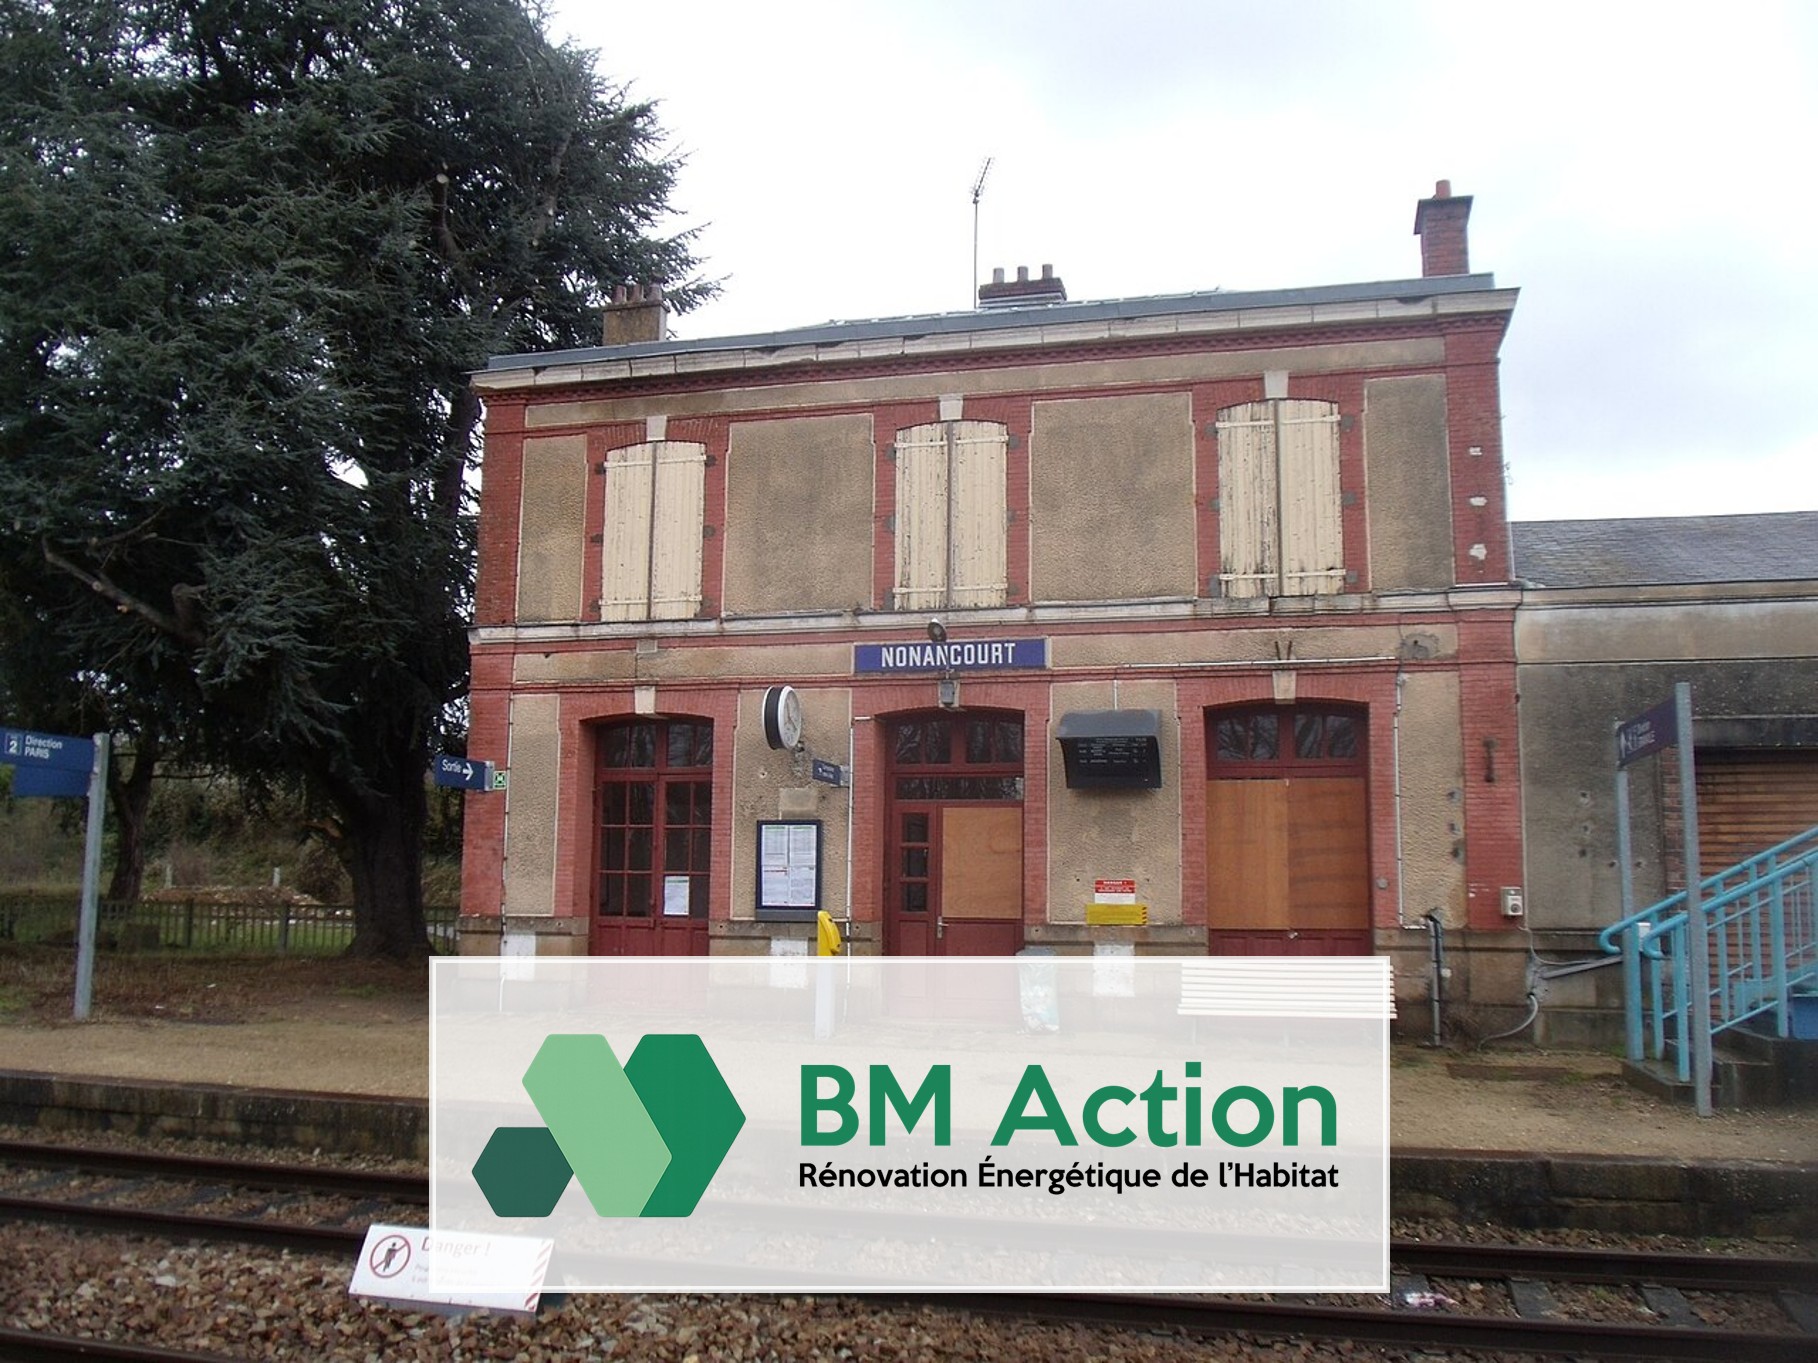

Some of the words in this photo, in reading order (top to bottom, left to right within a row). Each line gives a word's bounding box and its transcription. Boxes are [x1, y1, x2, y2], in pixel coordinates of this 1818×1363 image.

[881, 643, 1016, 668] NONANCOURT
[9, 740, 18, 755] 2
[25, 735, 63, 750] Direction
[24, 746, 50, 759] PARIS
[441, 759, 462, 773] Sortie
